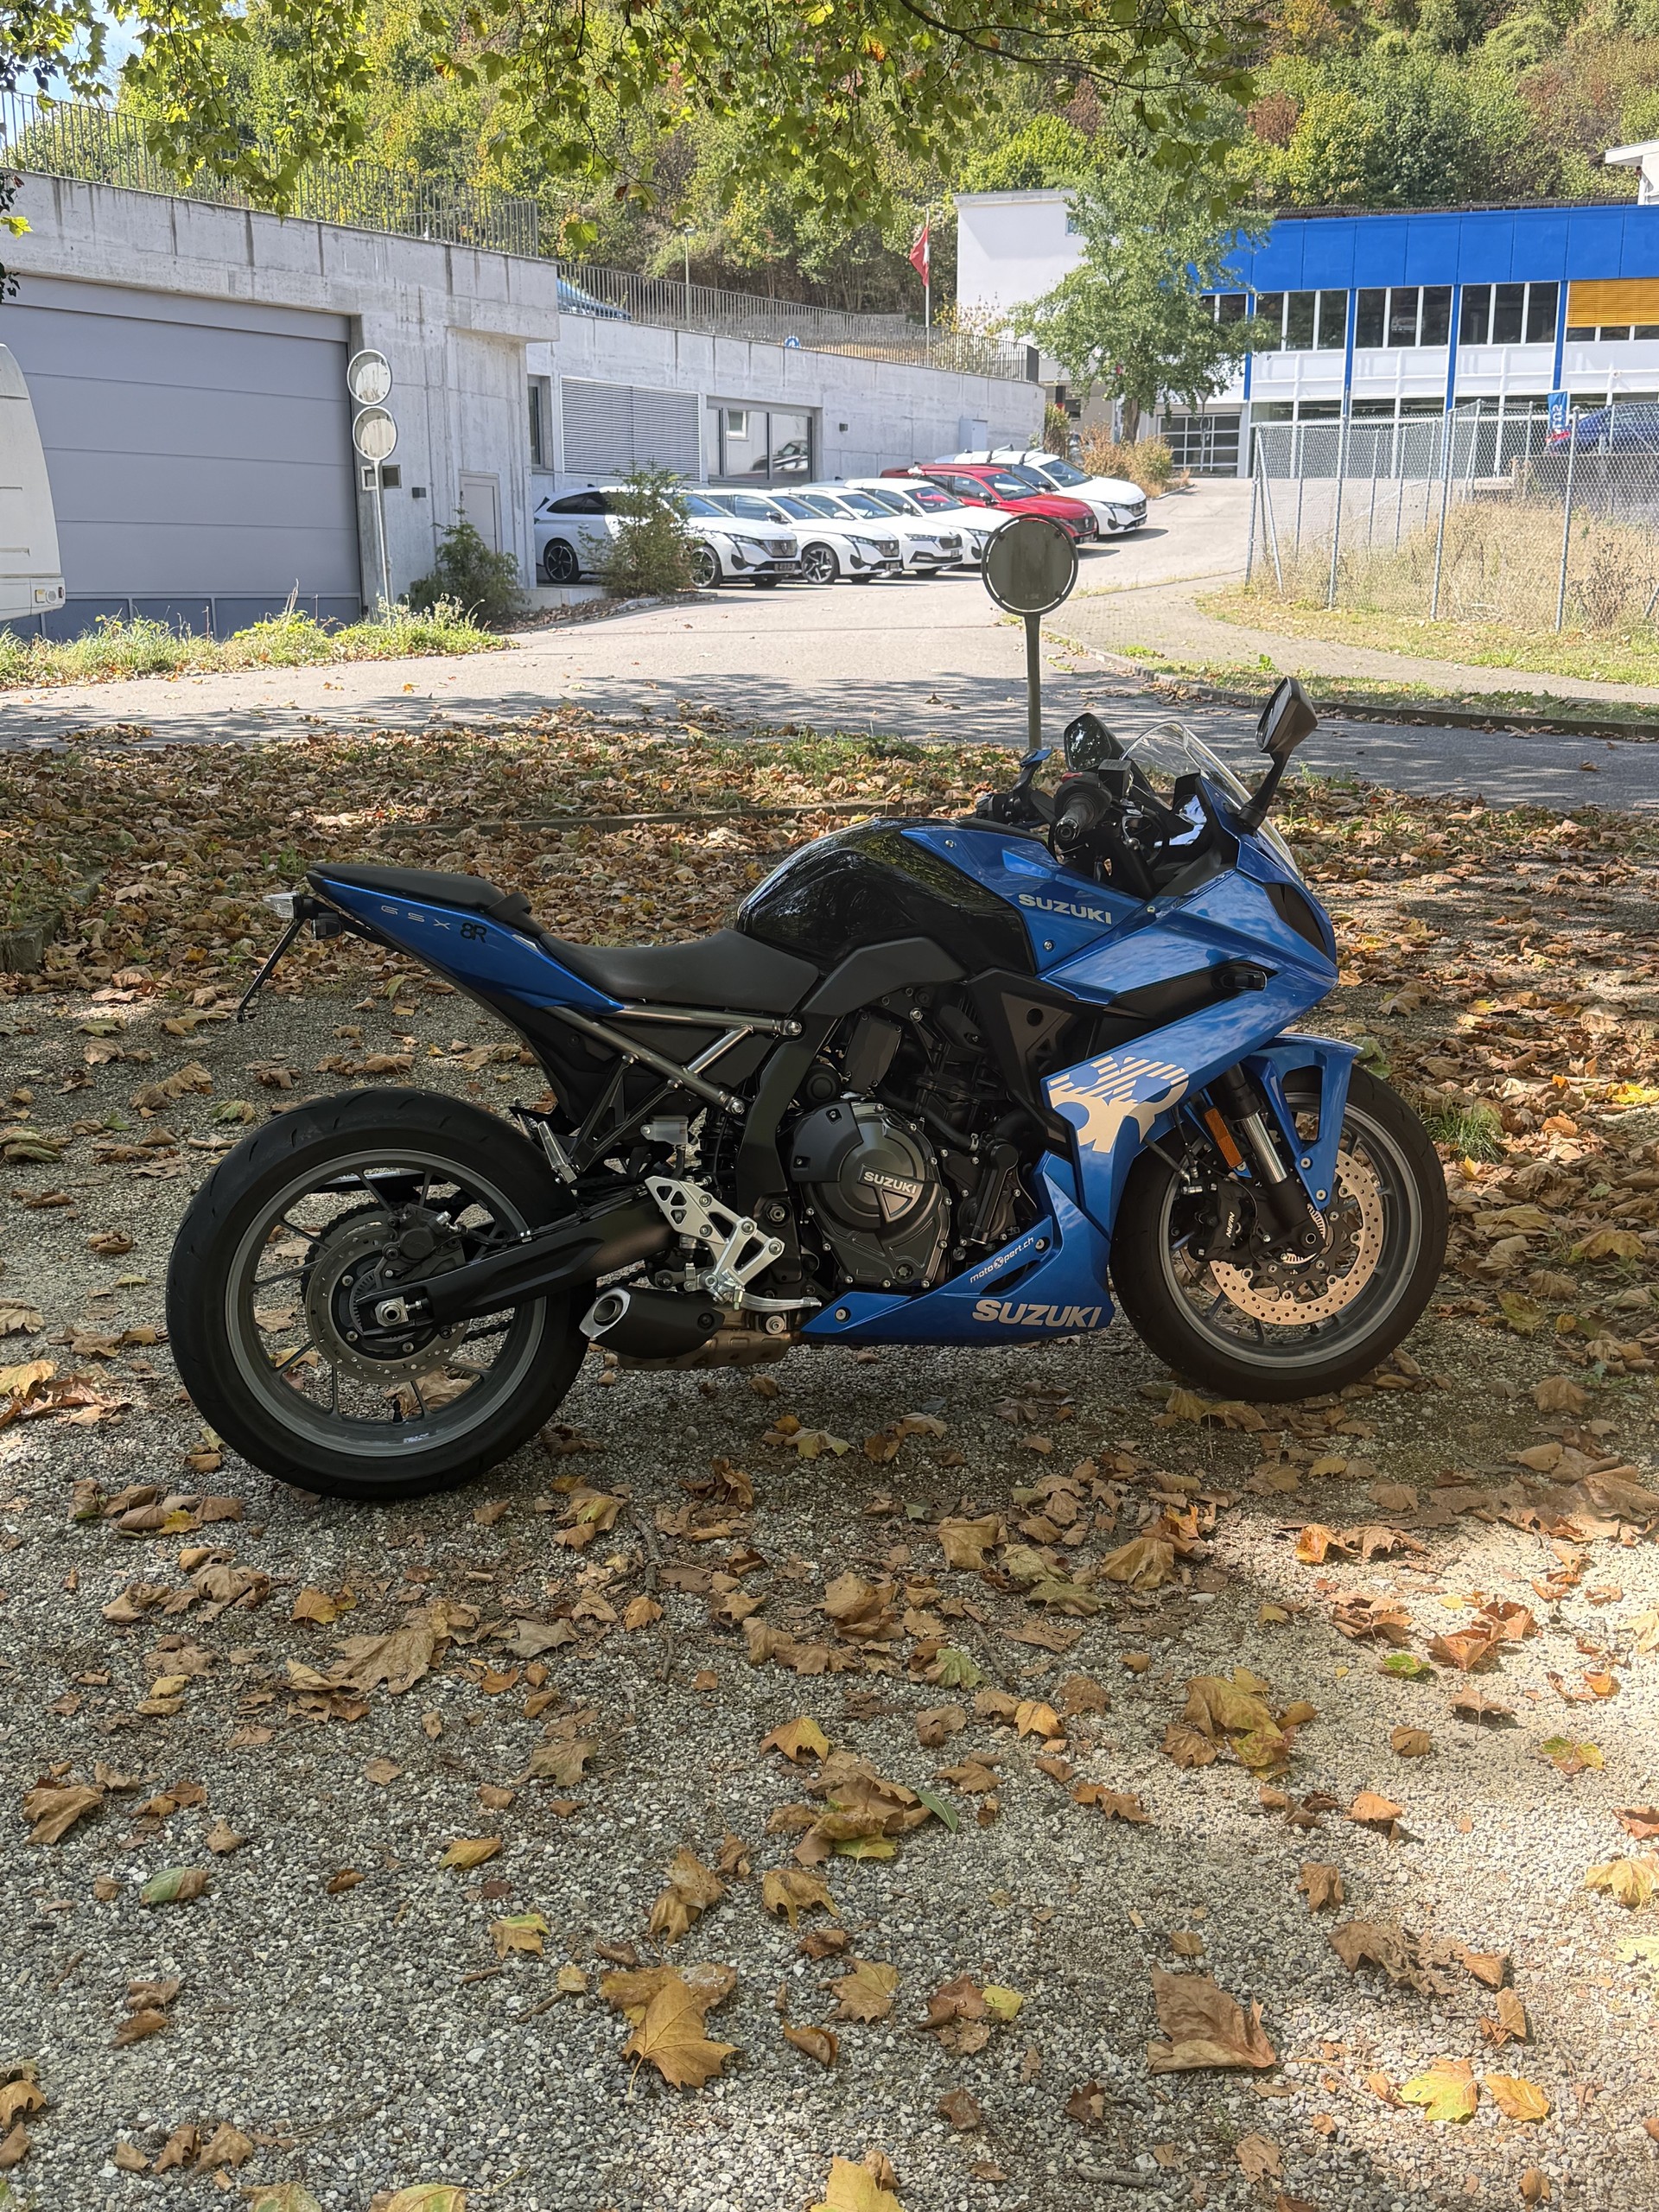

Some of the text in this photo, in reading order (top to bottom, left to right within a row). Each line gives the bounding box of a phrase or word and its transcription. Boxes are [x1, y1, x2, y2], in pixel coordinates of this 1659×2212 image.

[1018, 893, 1112, 925] SUZUKI
[381, 905, 487, 944] GSX 8R
[863, 1171, 917, 1194] SUZUKI
[972, 1299, 1103, 1328] SUZUKI
